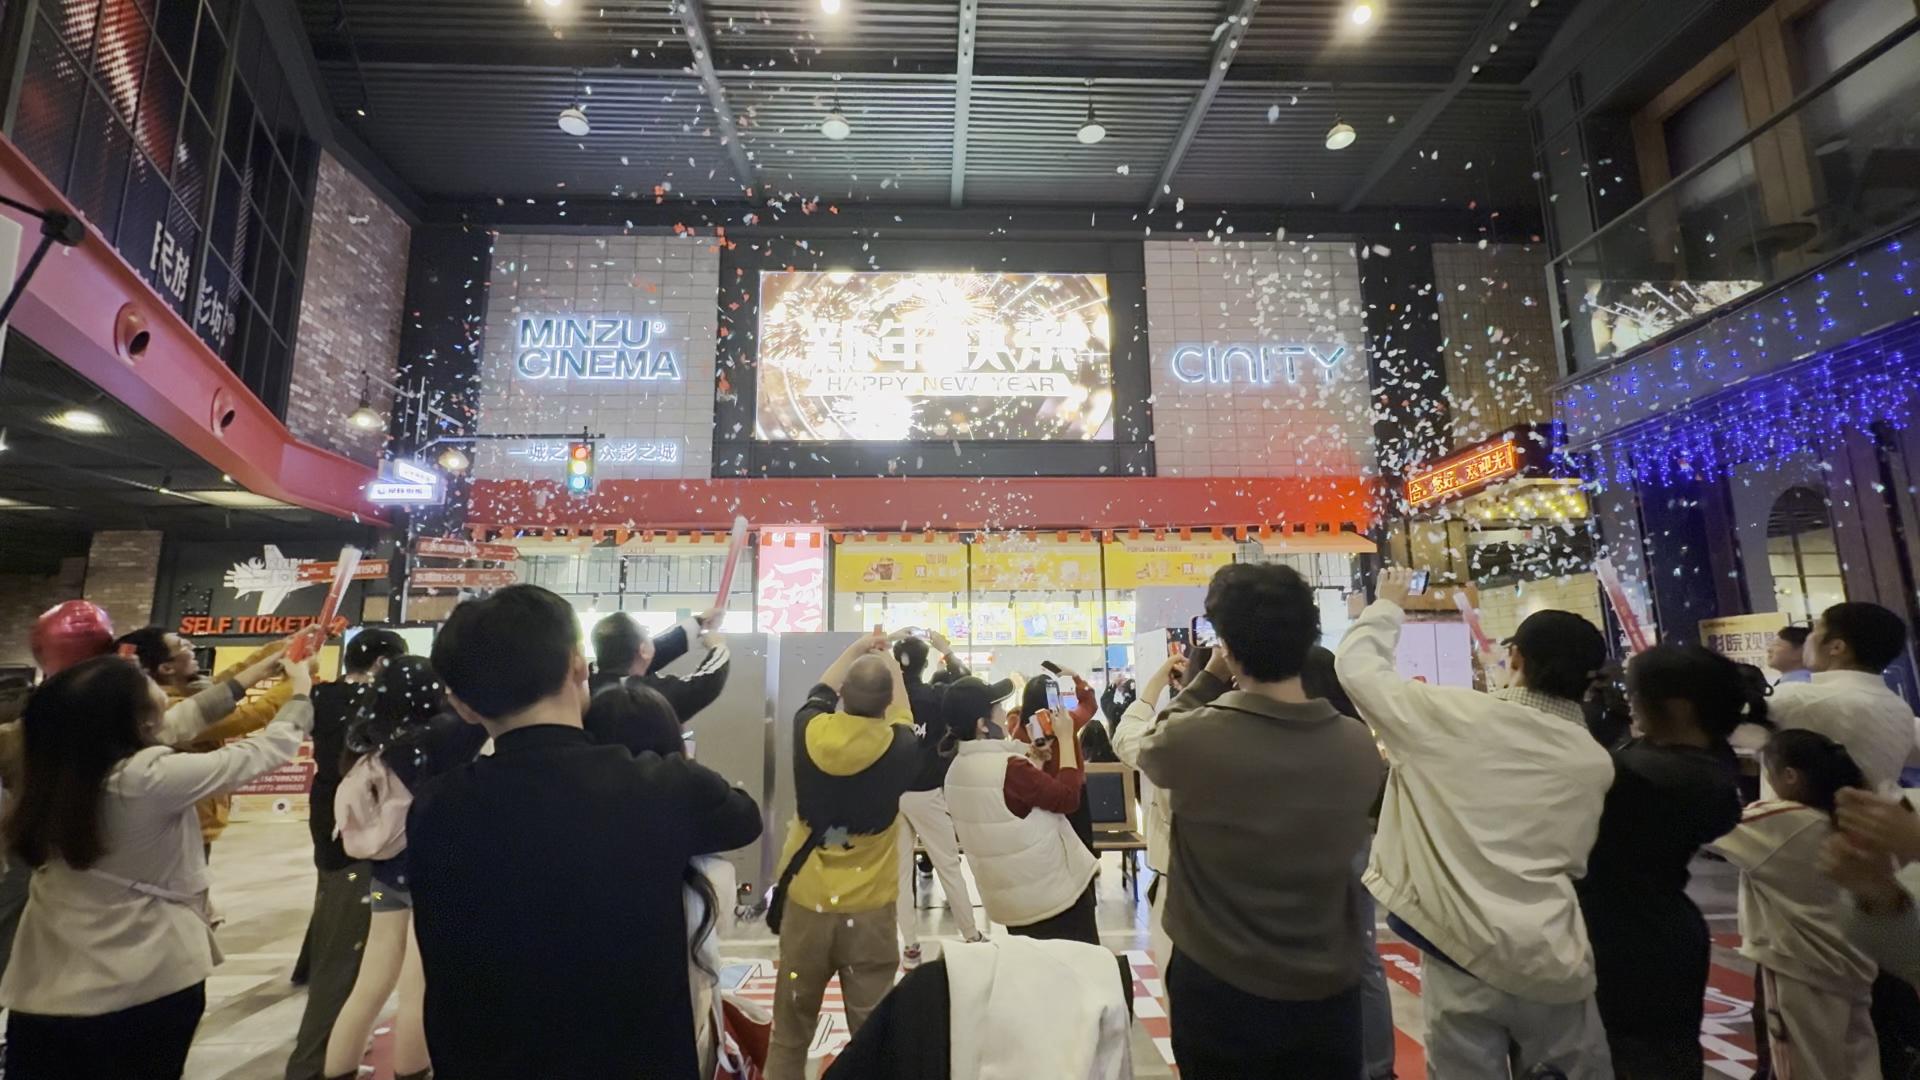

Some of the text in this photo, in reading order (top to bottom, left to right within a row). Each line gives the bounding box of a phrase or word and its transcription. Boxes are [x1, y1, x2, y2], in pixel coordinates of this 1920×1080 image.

[517, 349, 681, 381] CINEMA
[1172, 345, 1345, 384] CINITY
[827, 376, 1055, 392] HAPPY NEW YEAR
[179, 615, 347, 635] SELF TICKET
